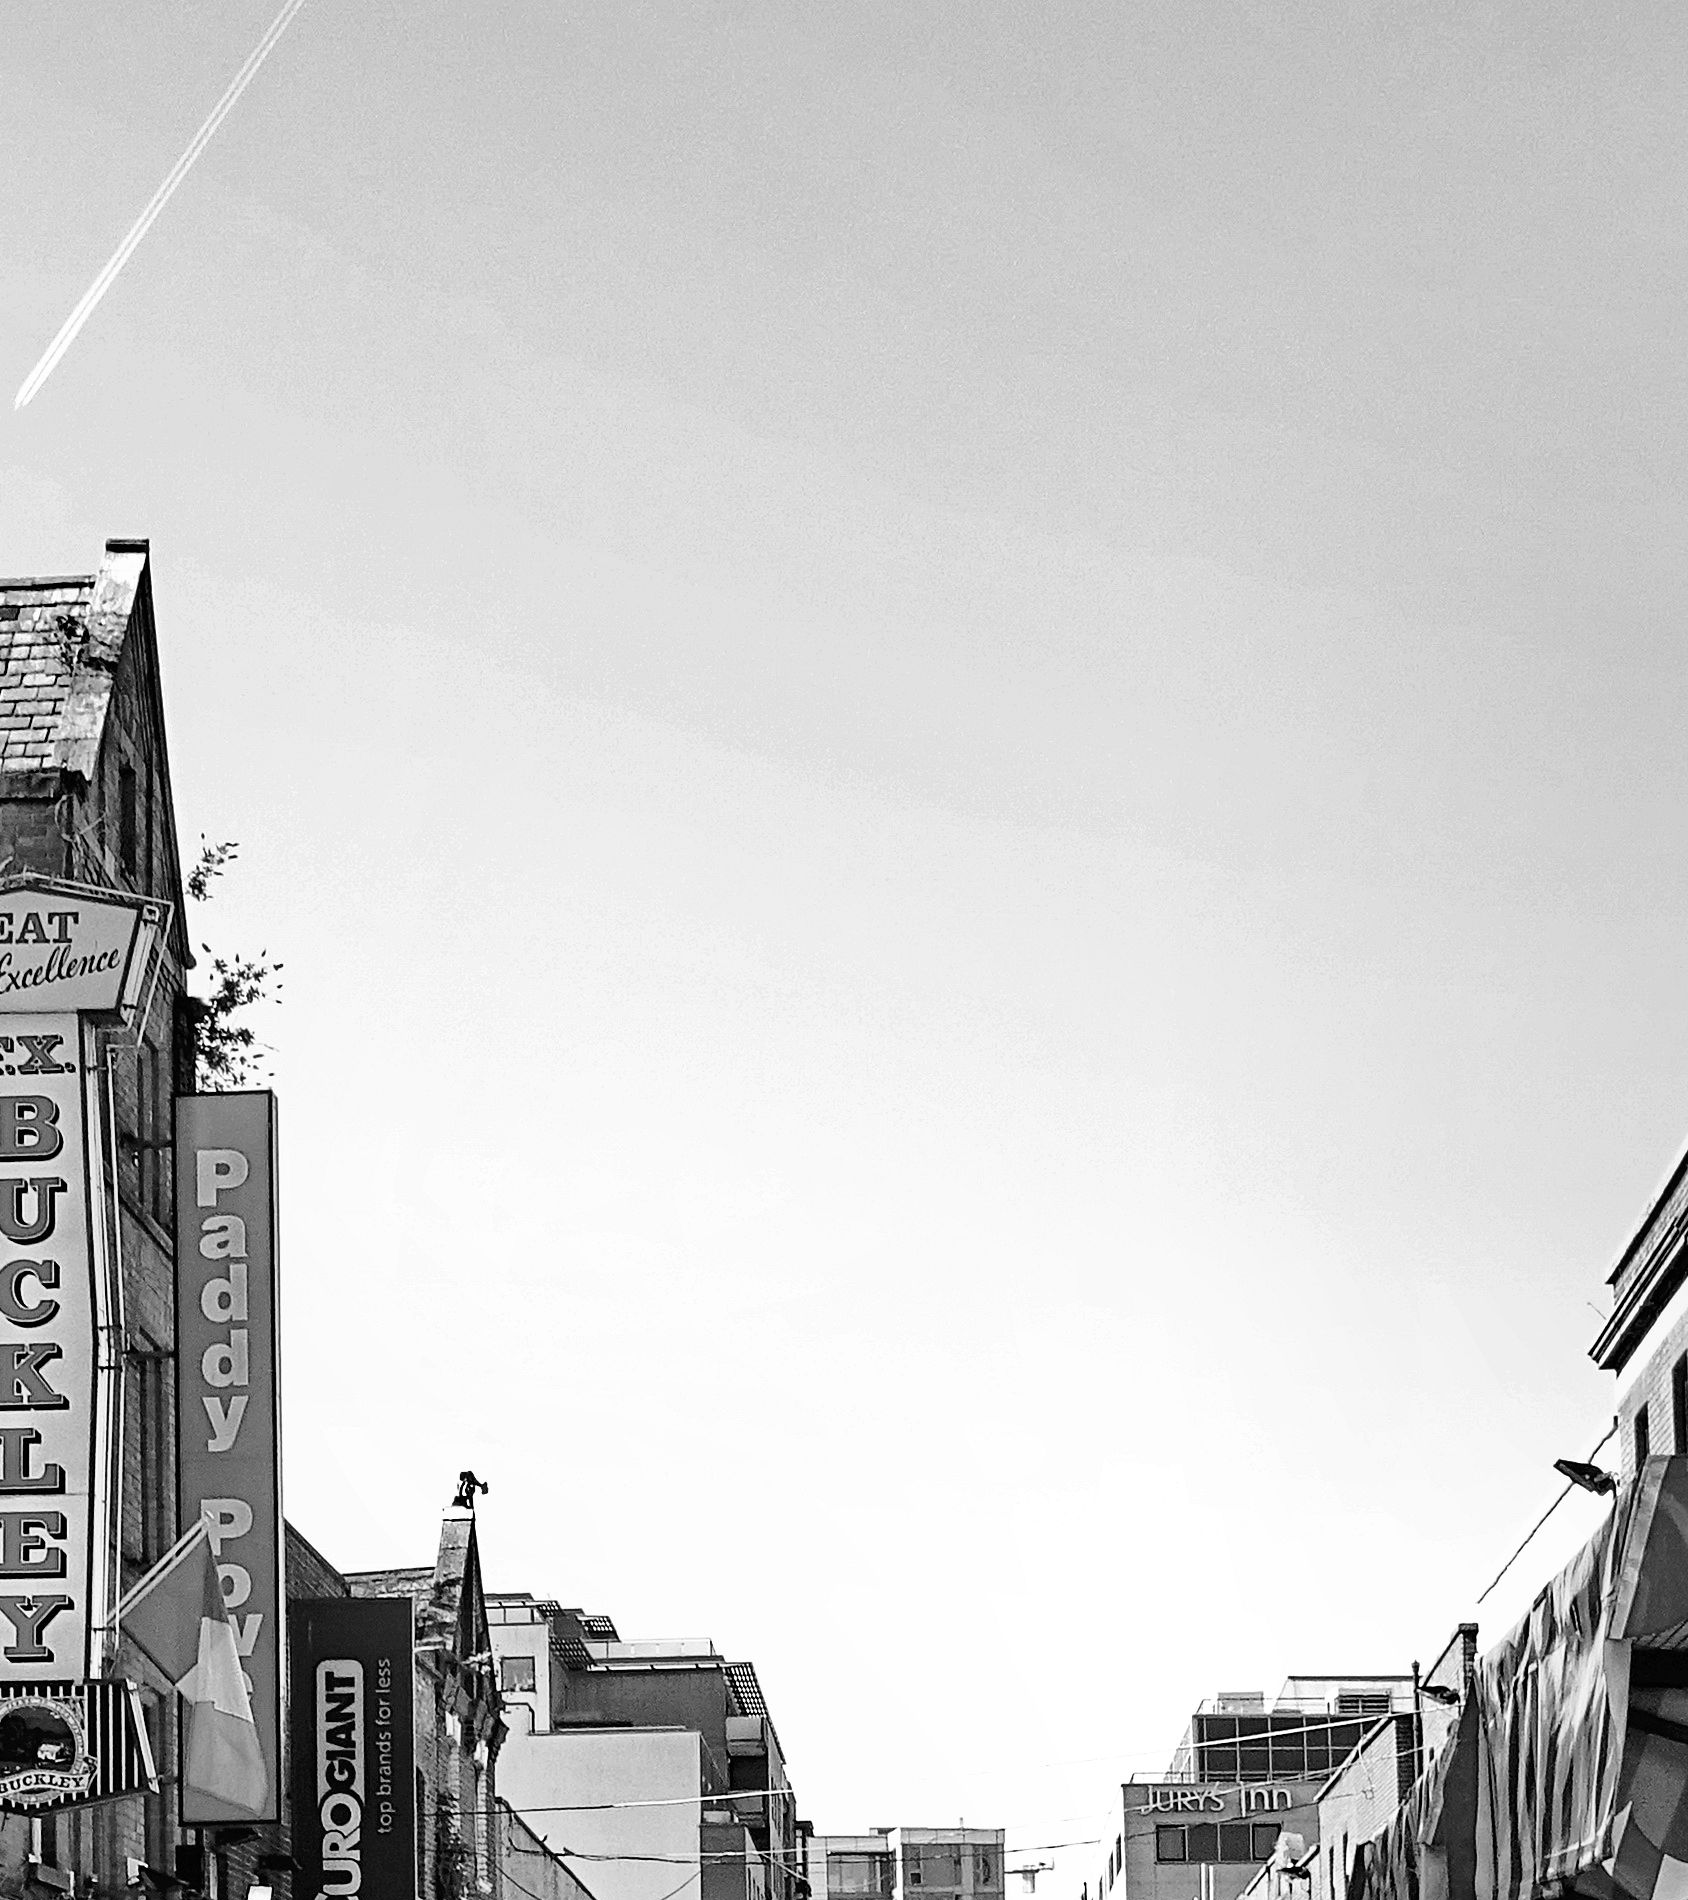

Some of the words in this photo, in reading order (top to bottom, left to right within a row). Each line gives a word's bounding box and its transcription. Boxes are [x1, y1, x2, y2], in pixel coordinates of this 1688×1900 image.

[196, 1148, 252, 1453] Paddy
[375, 1657, 391, 1694] less
[375, 1698, 392, 1727] for
[376, 1729, 392, 1796] brands
[377, 1800, 395, 1834] top
[1239, 1781, 1293, 1817] Inn
